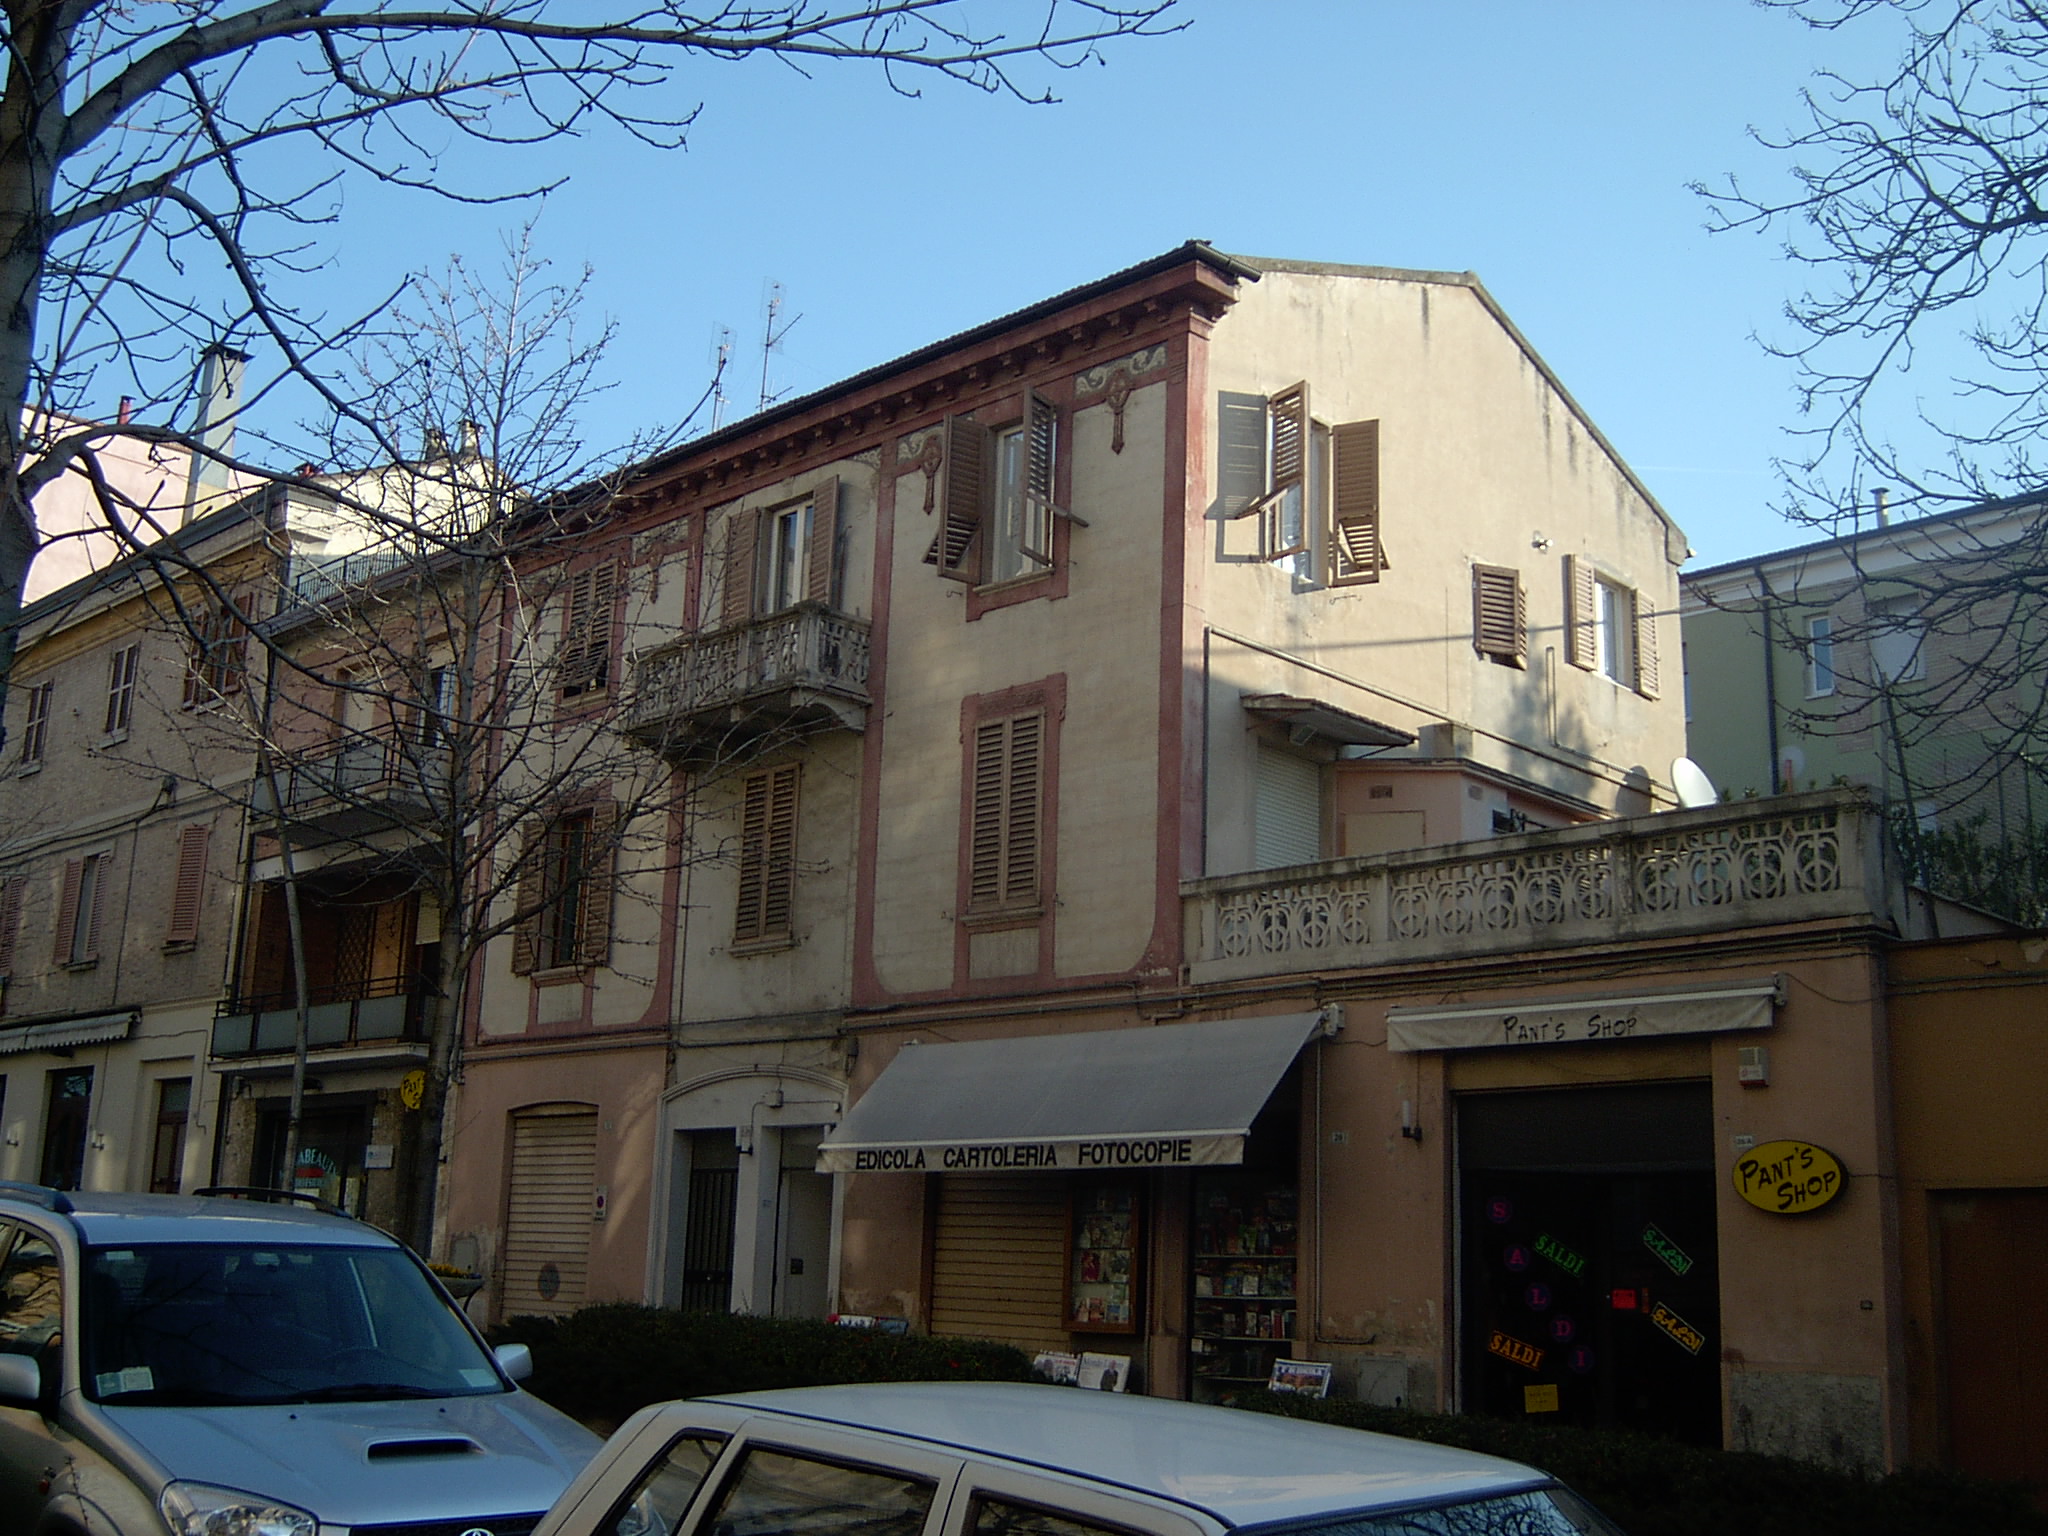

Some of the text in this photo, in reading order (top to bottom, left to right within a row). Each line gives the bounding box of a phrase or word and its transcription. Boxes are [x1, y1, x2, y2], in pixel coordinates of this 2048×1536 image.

[1503, 1013, 1638, 1044] PANT'S SHOP
[855, 1138, 1192, 1170] EDICOLA CARTOLERIA FOTOCOPIE
[1739, 1146, 1814, 1194] PANT'S
[1776, 1170, 1837, 1210] SHOP
[1534, 1232, 1586, 1277] SALDI
[1641, 1228, 1689, 1274] SALDI
[1489, 1333, 1545, 1368] SALDI
[1651, 1307, 1702, 1352] SALDI
